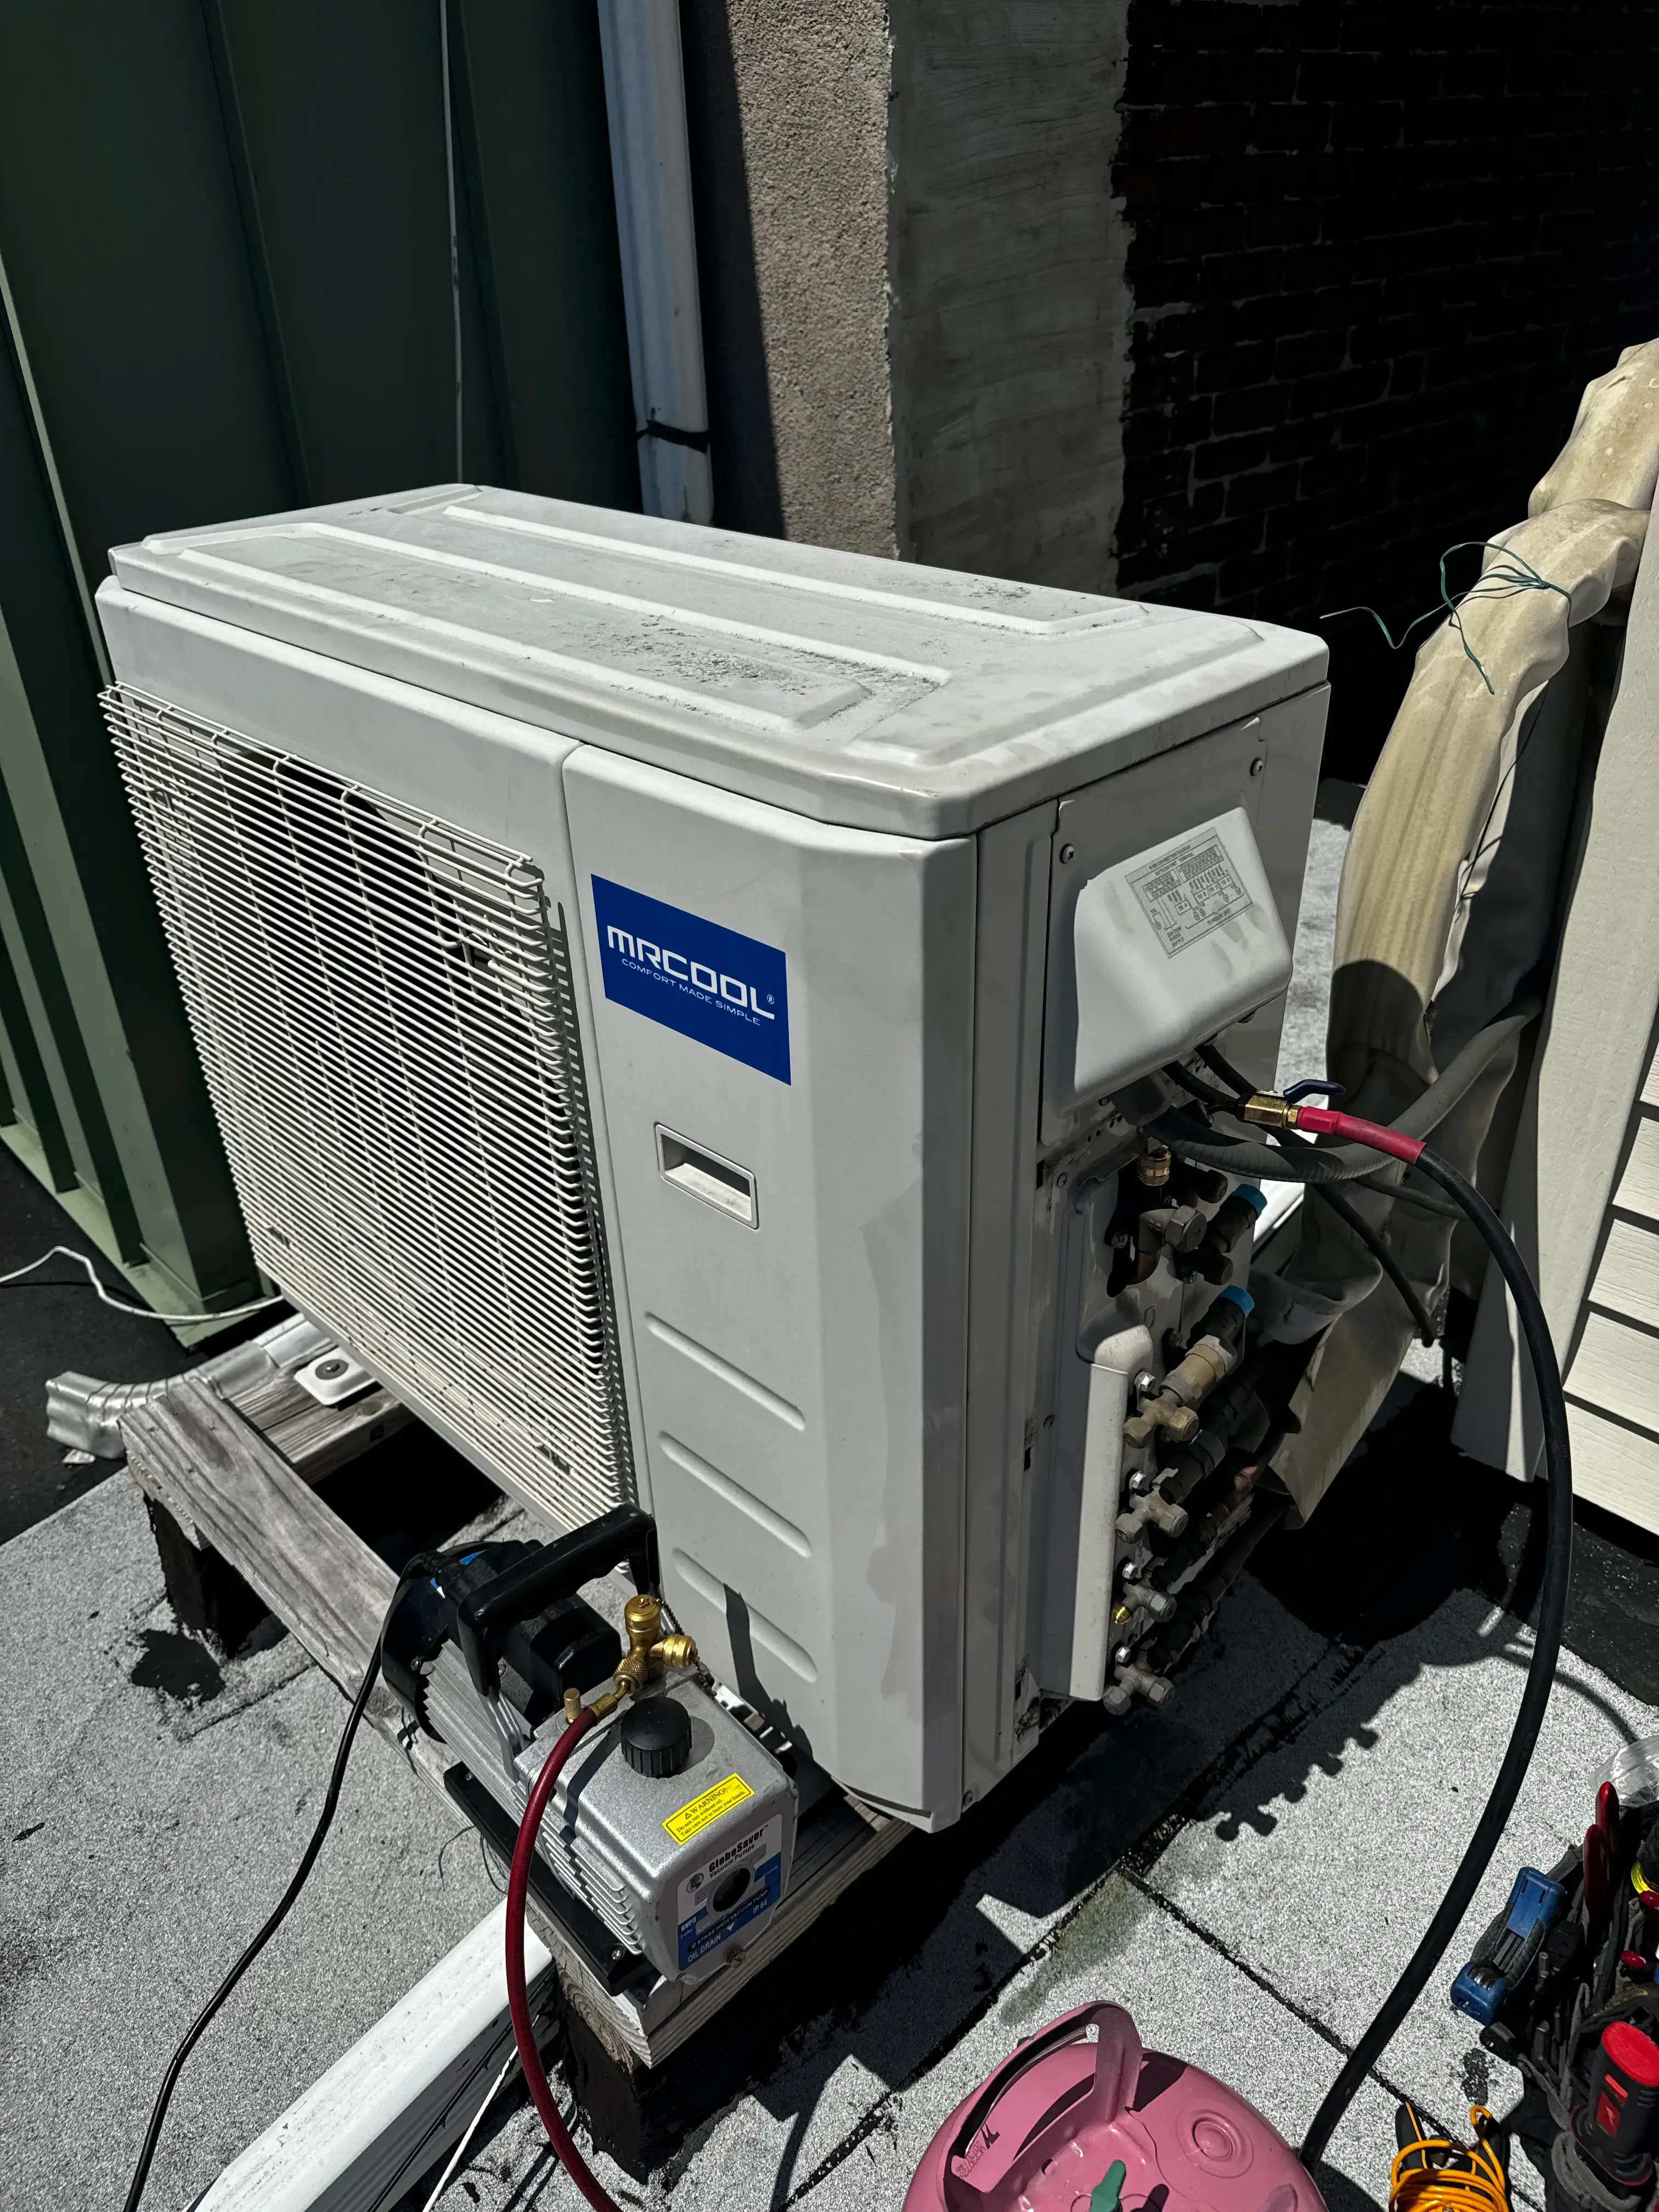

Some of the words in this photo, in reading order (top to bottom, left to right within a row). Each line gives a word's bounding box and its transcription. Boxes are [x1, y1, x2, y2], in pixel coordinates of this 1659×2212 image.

[622, 958, 676, 987] COMFORT
[679, 983, 713, 1005] MADE
[715, 1000, 761, 1026] SIMPLE
[690, 1787, 727, 1814] WARNING!
[700, 1804, 716, 1815] without
[680, 1827, 692, 1836] Take
[692, 1820, 701, 1829] care
[712, 1805, 723, 1814] burn
[723, 1799, 733, 1808] your
[710, 1859, 733, 1878] Vacuum
[735, 1843, 755, 1861] Pumps
[681, 1916, 697, 1931] GVP3
[697, 1928, 715, 1945] STAGE
[716, 1918, 729, 1931] HIGH
[730, 1901, 753, 1920] VACUUM
[753, 1889, 768, 1904] PUMP
[753, 1905, 759, 1914] IP
[688, 1951, 699, 1962] OIL
[701, 1933, 721, 1953] DRAIN
